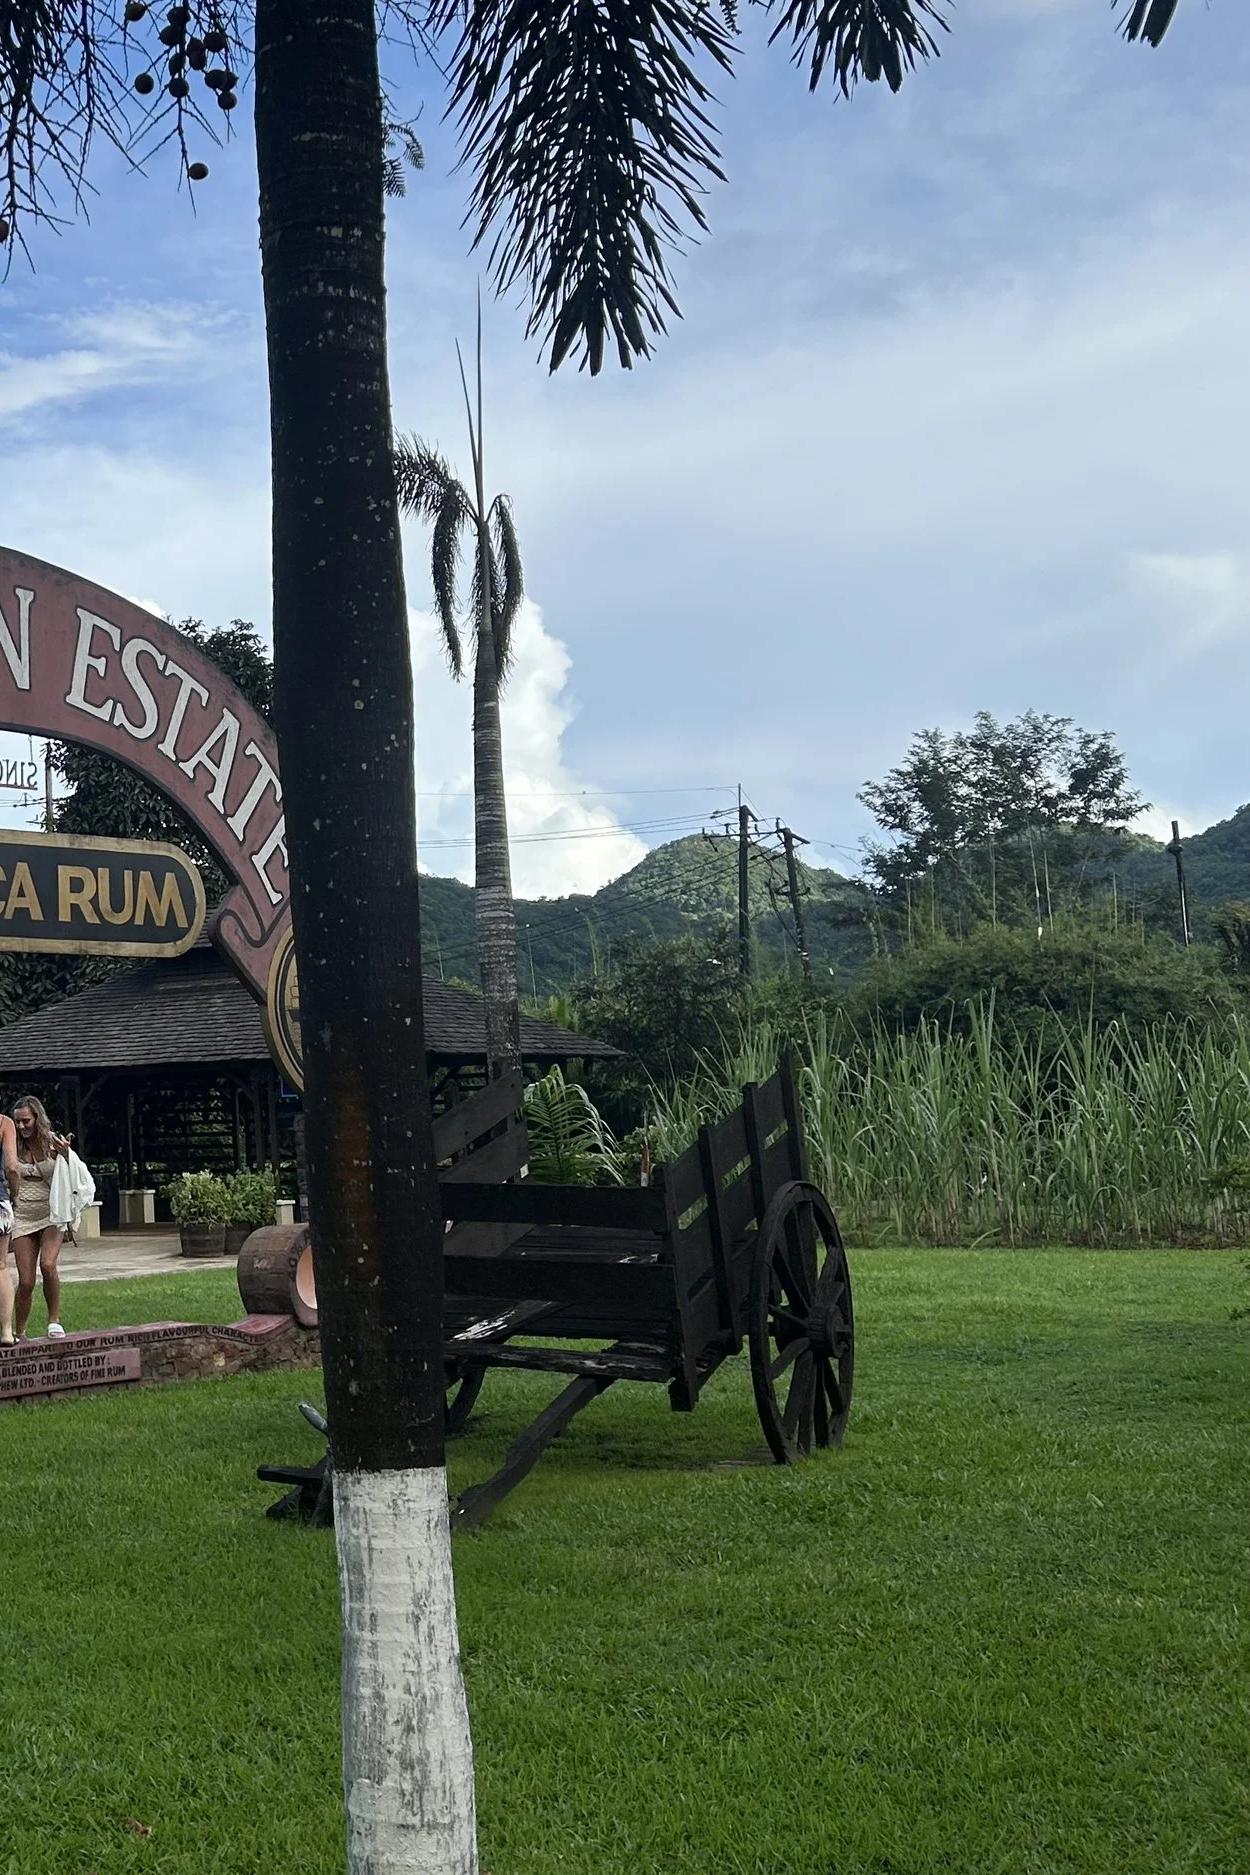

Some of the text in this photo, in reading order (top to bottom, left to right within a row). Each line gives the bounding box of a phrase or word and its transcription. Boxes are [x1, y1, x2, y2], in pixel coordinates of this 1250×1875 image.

[66, 607, 290, 905] ESTATE
[58, 864, 189, 928] RUM
[18, 1345, 55, 1357] IMPAR
[75, 1339, 96, 1349] OUR
[100, 1336, 125, 1346] RUM
[151, 1326, 210, 1342] FLAVOURFUL
[2, 1363, 37, 1379] BLENDED
[39, 1361, 55, 1374] AND
[57, 1357, 92, 1372] BOTTLED
[41, 1373, 79, 1386] CREATORS
[81, 1371, 89, 1381] OF
[91, 1367, 105, 1379] FINE
[108, 1365, 126, 1377] RUM
